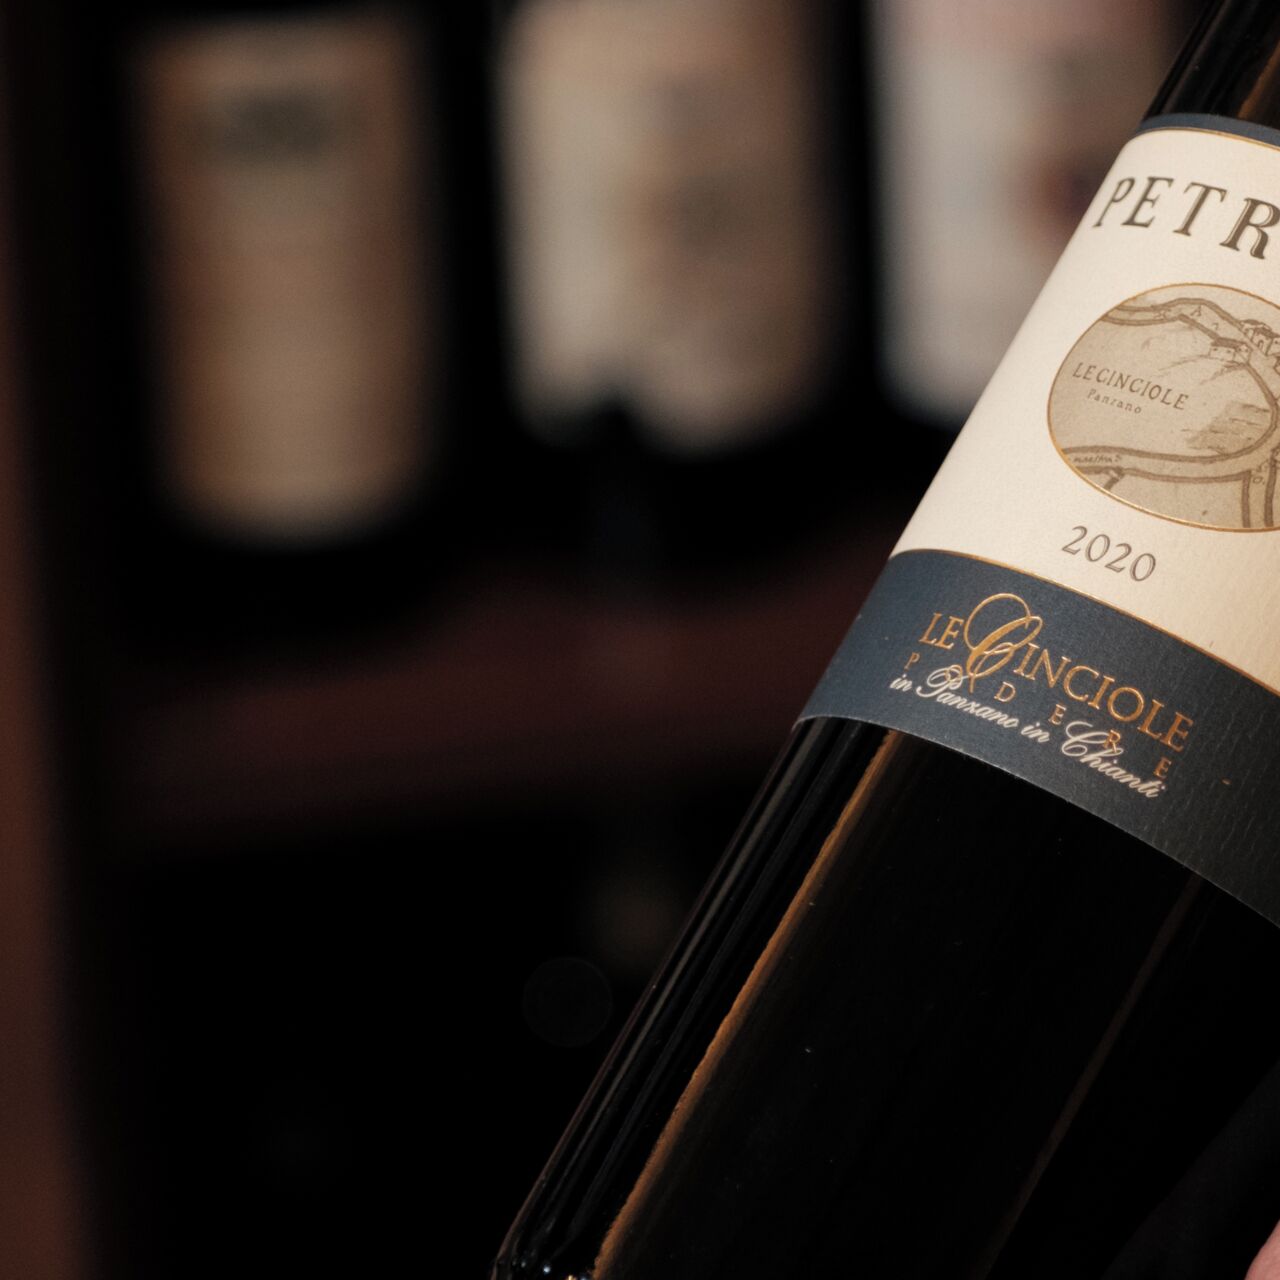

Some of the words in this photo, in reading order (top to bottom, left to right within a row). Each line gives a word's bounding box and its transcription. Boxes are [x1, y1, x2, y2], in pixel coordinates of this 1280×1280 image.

[1087, 388, 1142, 415] Panzano
[1061, 525, 1157, 583] 2020
[919, 612, 964, 650] LE
[963, 592, 1194, 752] CINCIOLE
[889, 673, 913, 693] in
[916, 665, 1021, 730] Panzano
[1020, 721, 1051, 744] in
[1060, 720, 1167, 799] Chianti
